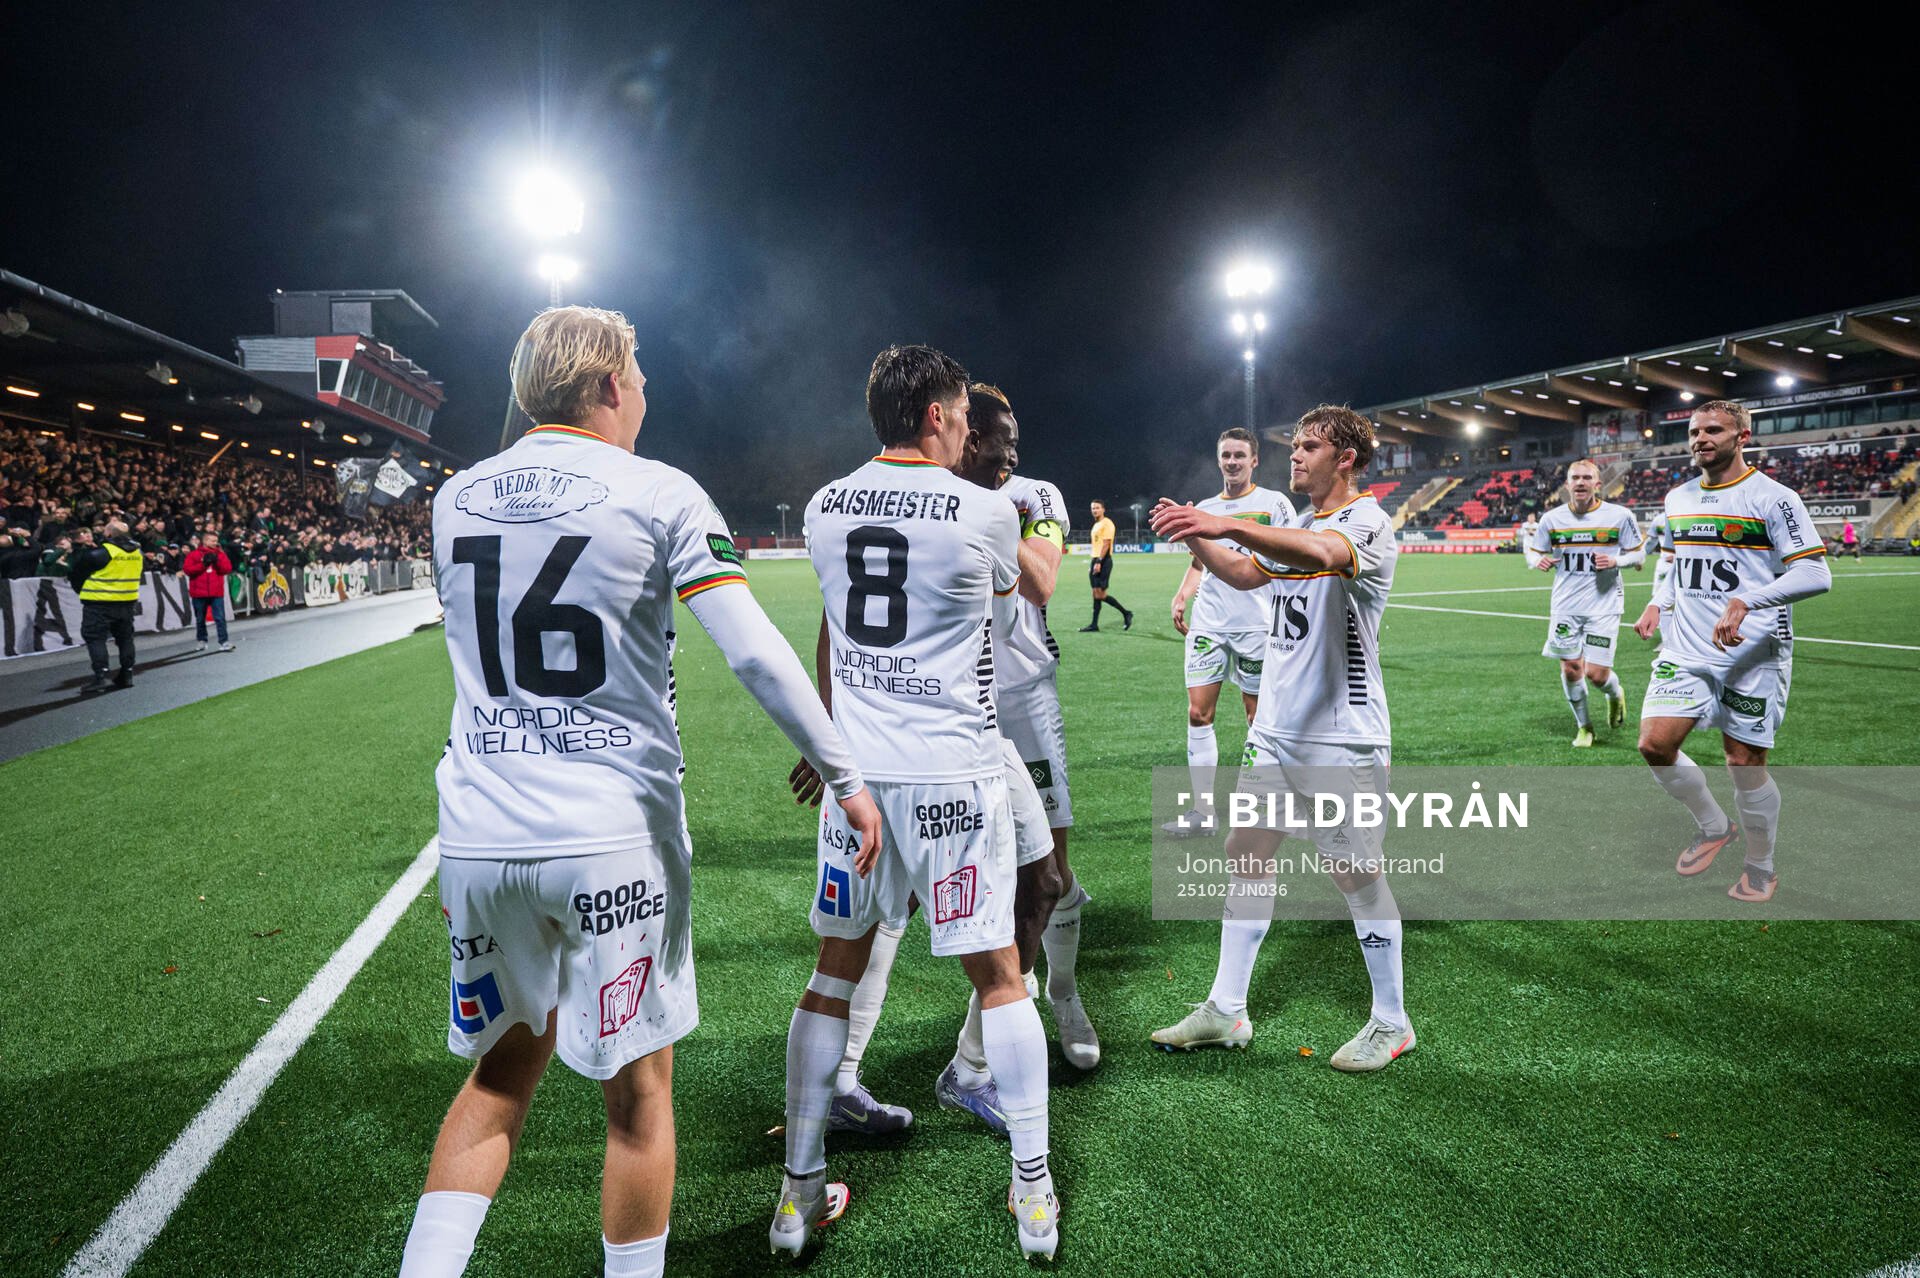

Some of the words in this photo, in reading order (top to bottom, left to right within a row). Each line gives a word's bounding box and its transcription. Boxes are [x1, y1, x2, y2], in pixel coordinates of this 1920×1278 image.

[821, 488, 961, 522] GAISMEISTER
[1033, 521, 1051, 538] C
[1778, 500, 1805, 548] stadium
[1115, 544, 1143, 552] DAHL
[845, 525, 909, 648] 8
[452, 535, 607, 698] 16
[836, 648, 916, 675] NORDIC
[474, 706, 595, 730] NORDIC
[466, 726, 632, 755] WELLNESS
[916, 800, 967, 822] GOOD
[919, 813, 983, 840] ADVICE
[574, 880, 647, 914] GOOD
[580, 893, 665, 936] ADVICE
[452, 934, 504, 962] STA
